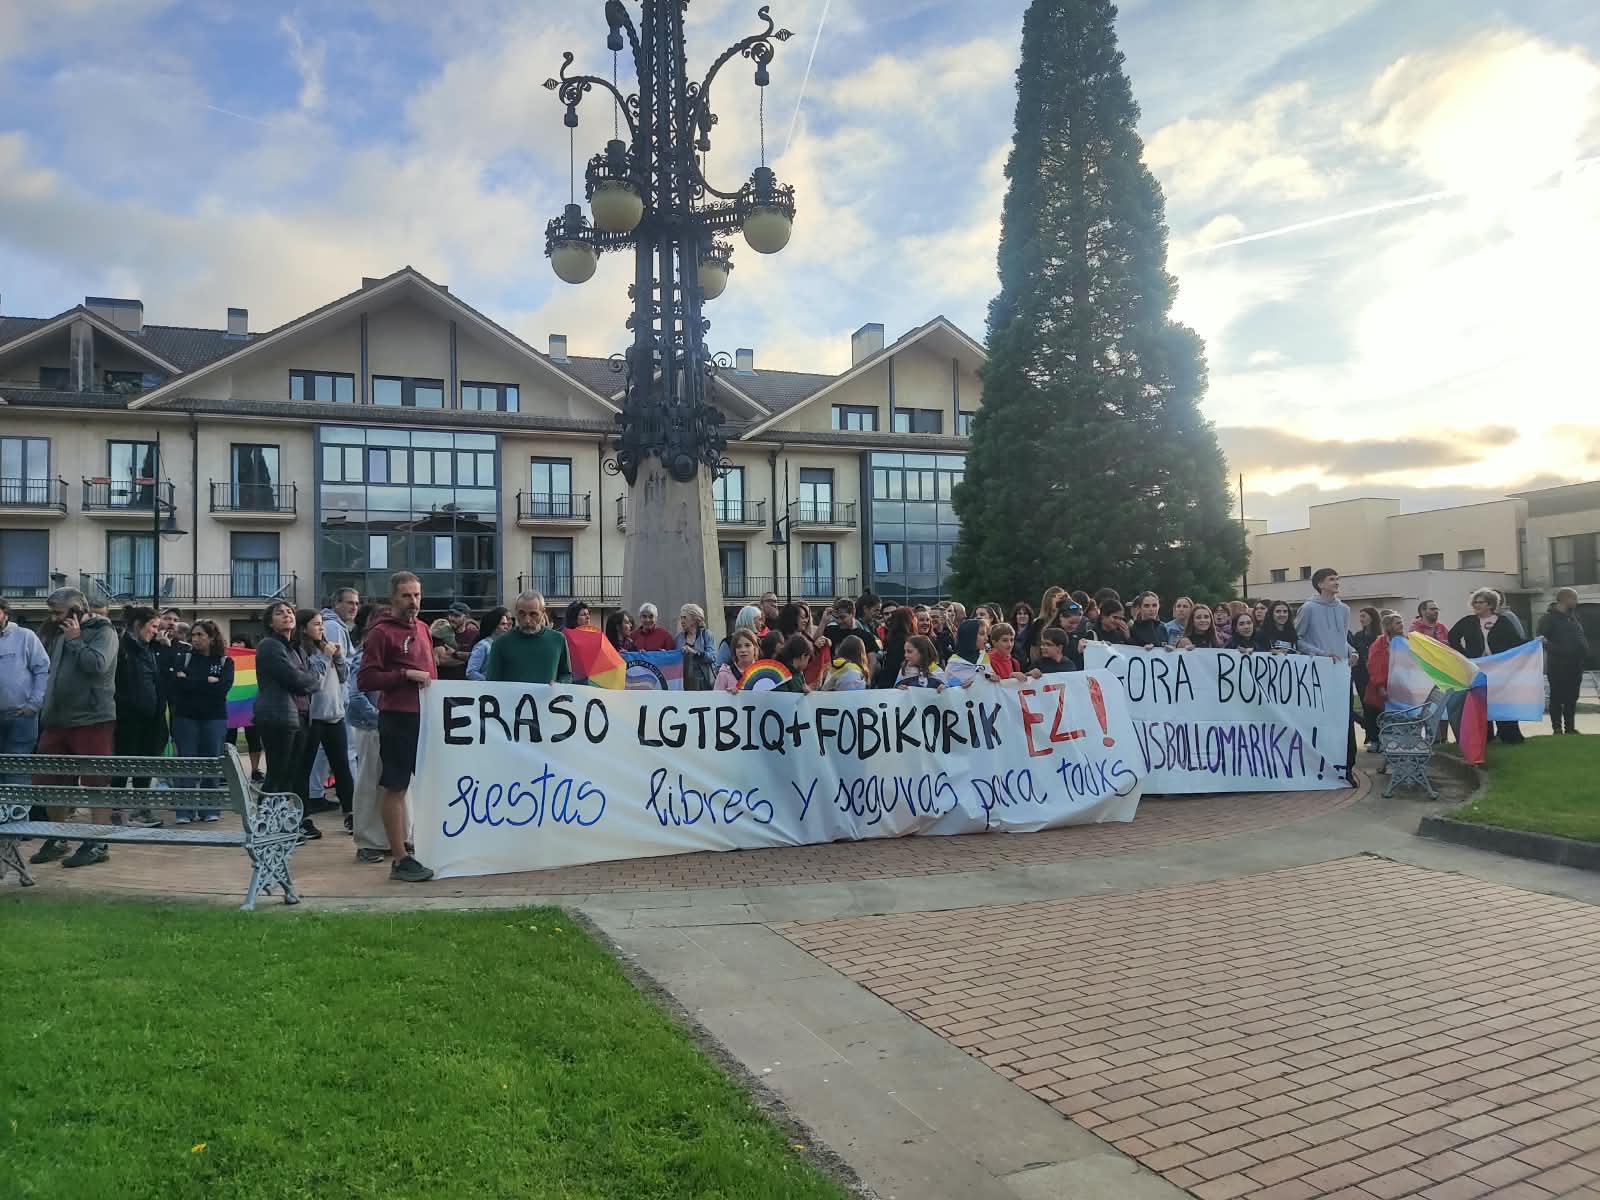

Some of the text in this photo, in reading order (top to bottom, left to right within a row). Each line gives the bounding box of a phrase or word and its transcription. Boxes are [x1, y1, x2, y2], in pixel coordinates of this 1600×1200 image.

[443, 694, 609, 745] ERASO
[1018, 676, 1115, 758] EZ!
[1218, 653, 1325, 712] BORROKA
[443, 763, 606, 837] fiestas
[646, 768, 774, 826] libres
[834, 771, 958, 825] seguras
[971, 768, 1047, 831] para
